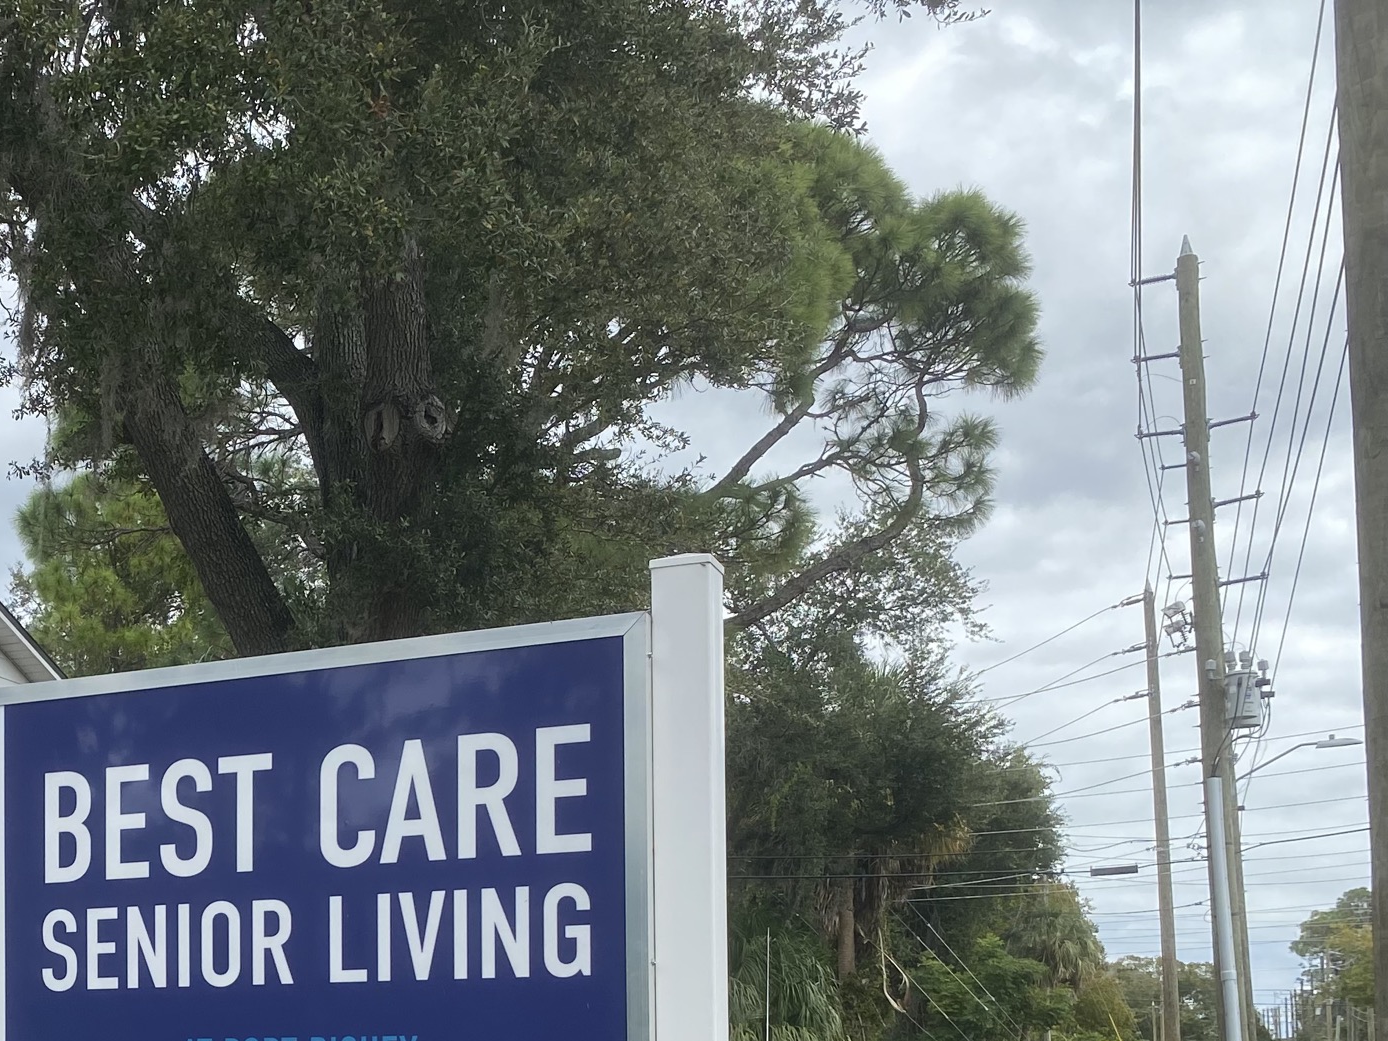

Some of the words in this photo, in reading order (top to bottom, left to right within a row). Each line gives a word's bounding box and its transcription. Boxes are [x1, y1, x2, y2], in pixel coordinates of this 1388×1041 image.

[45, 753, 272, 883] BEST
[320, 724, 591, 867] CARE
[42, 900, 293, 991] SENIOR
[330, 883, 591, 982] LIVING
